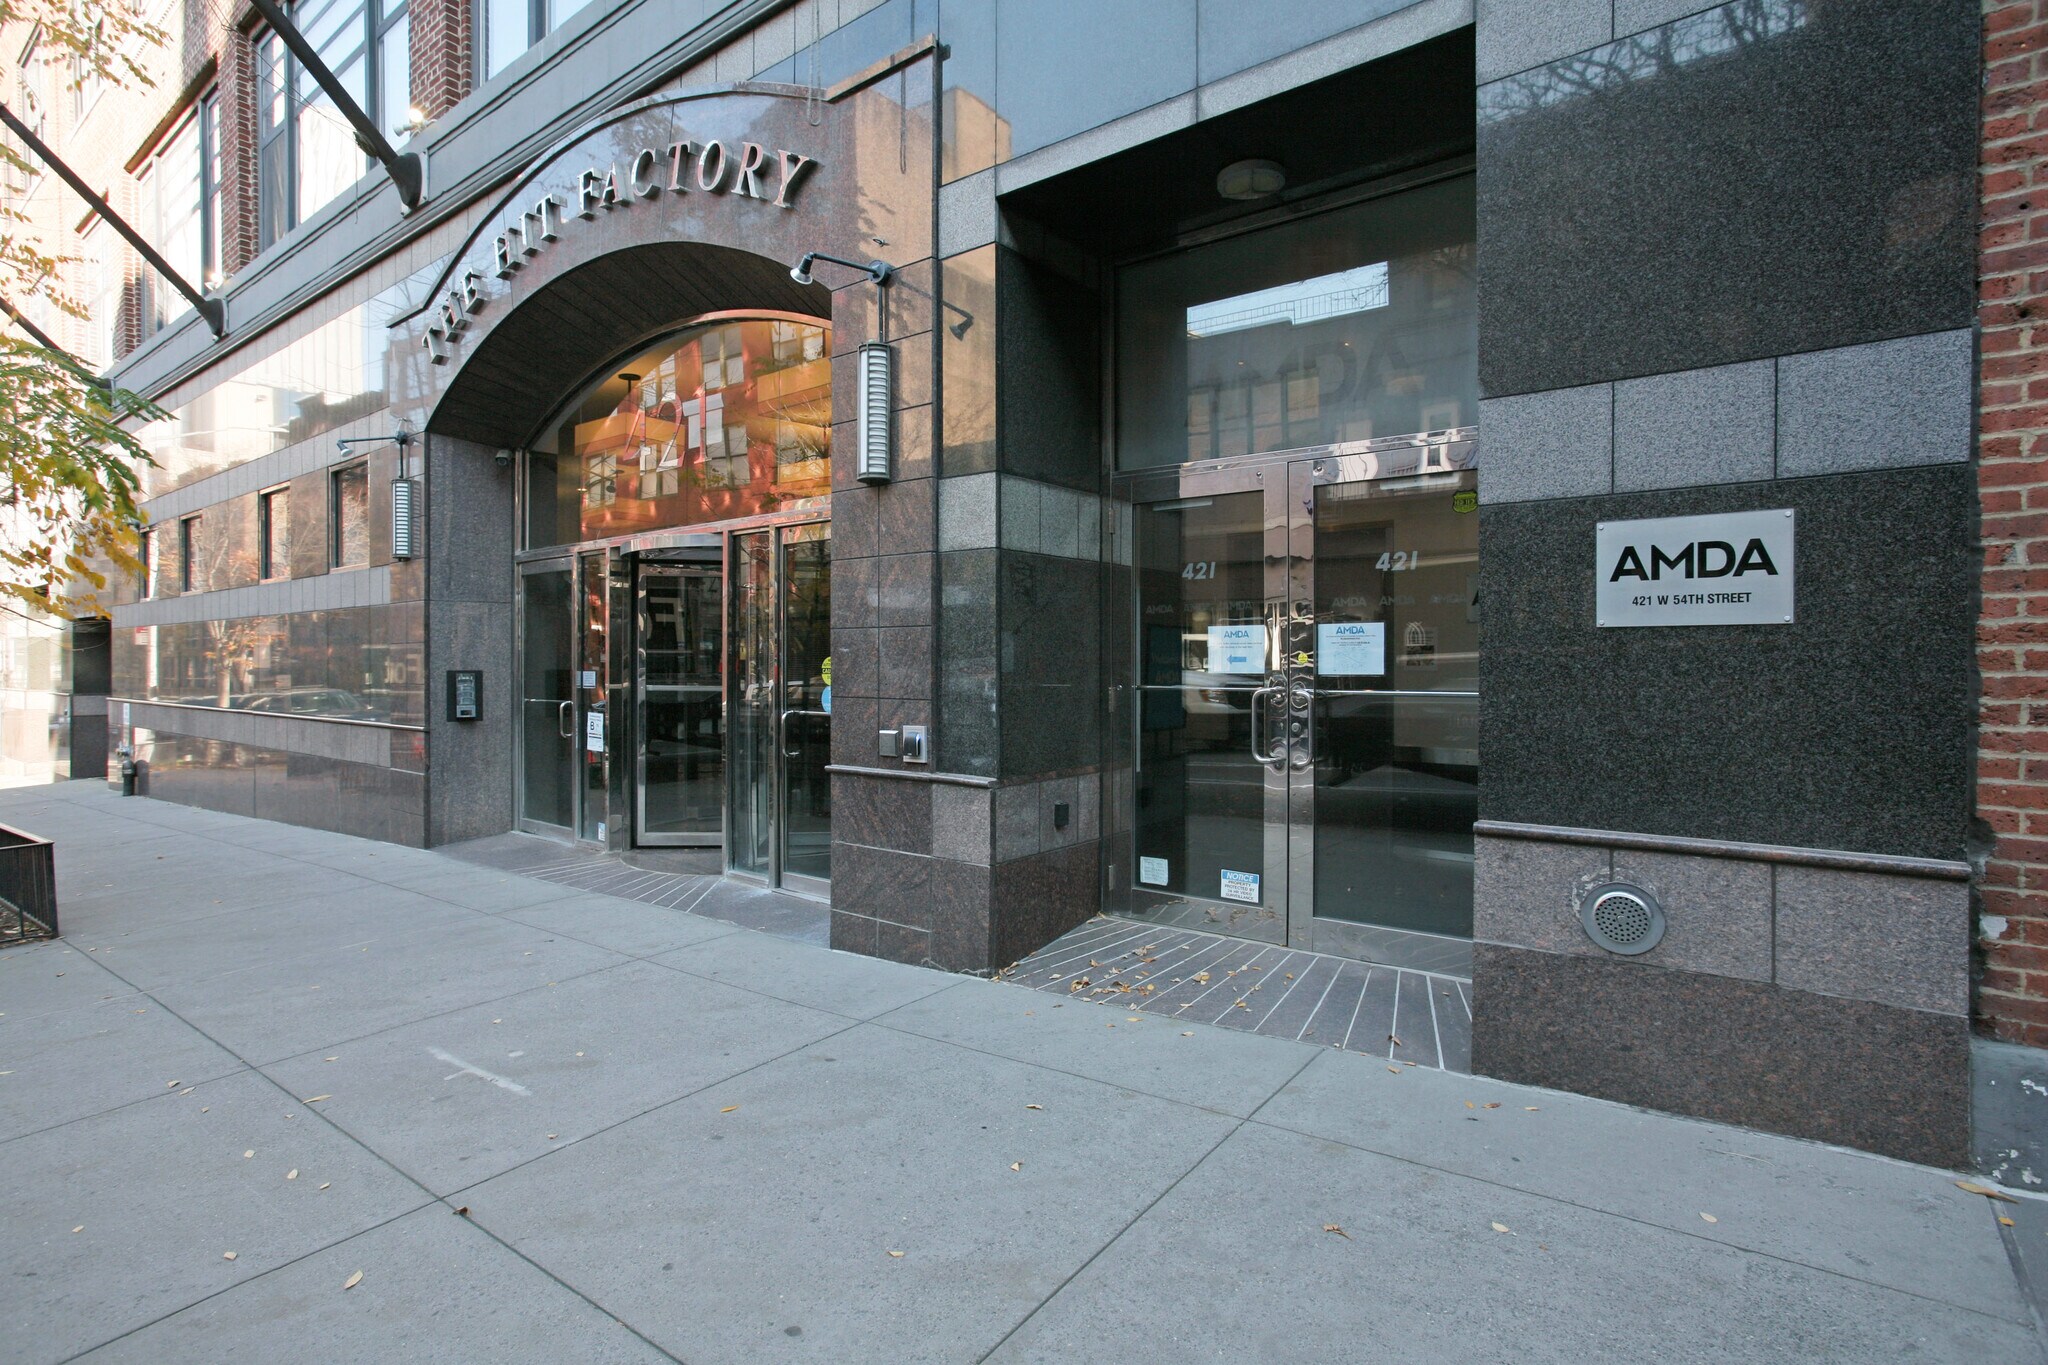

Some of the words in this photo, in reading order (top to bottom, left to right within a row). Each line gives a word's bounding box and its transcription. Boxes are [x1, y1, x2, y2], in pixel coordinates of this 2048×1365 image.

[420, 266, 490, 366] THE
[492, 192, 568, 281] HIT
[576, 138, 818, 221] FACTORY
[622, 382, 713, 476] 421
[1374, 550, 1419, 572] 421
[1609, 537, 1779, 583] AMDA
[1181, 561, 1216, 580] 421
[1332, 596, 1368, 608] AMDA
[1632, 595, 1652, 606] 421
[1657, 595, 1669, 606] W
[1673, 593, 1704, 606] 54TH
[1707, 591, 1752, 605] STREET
[1223, 630, 1250, 639] AMDA
[1335, 625, 1366, 635] AMDA
[1226, 872, 1254, 882] NOTICE
